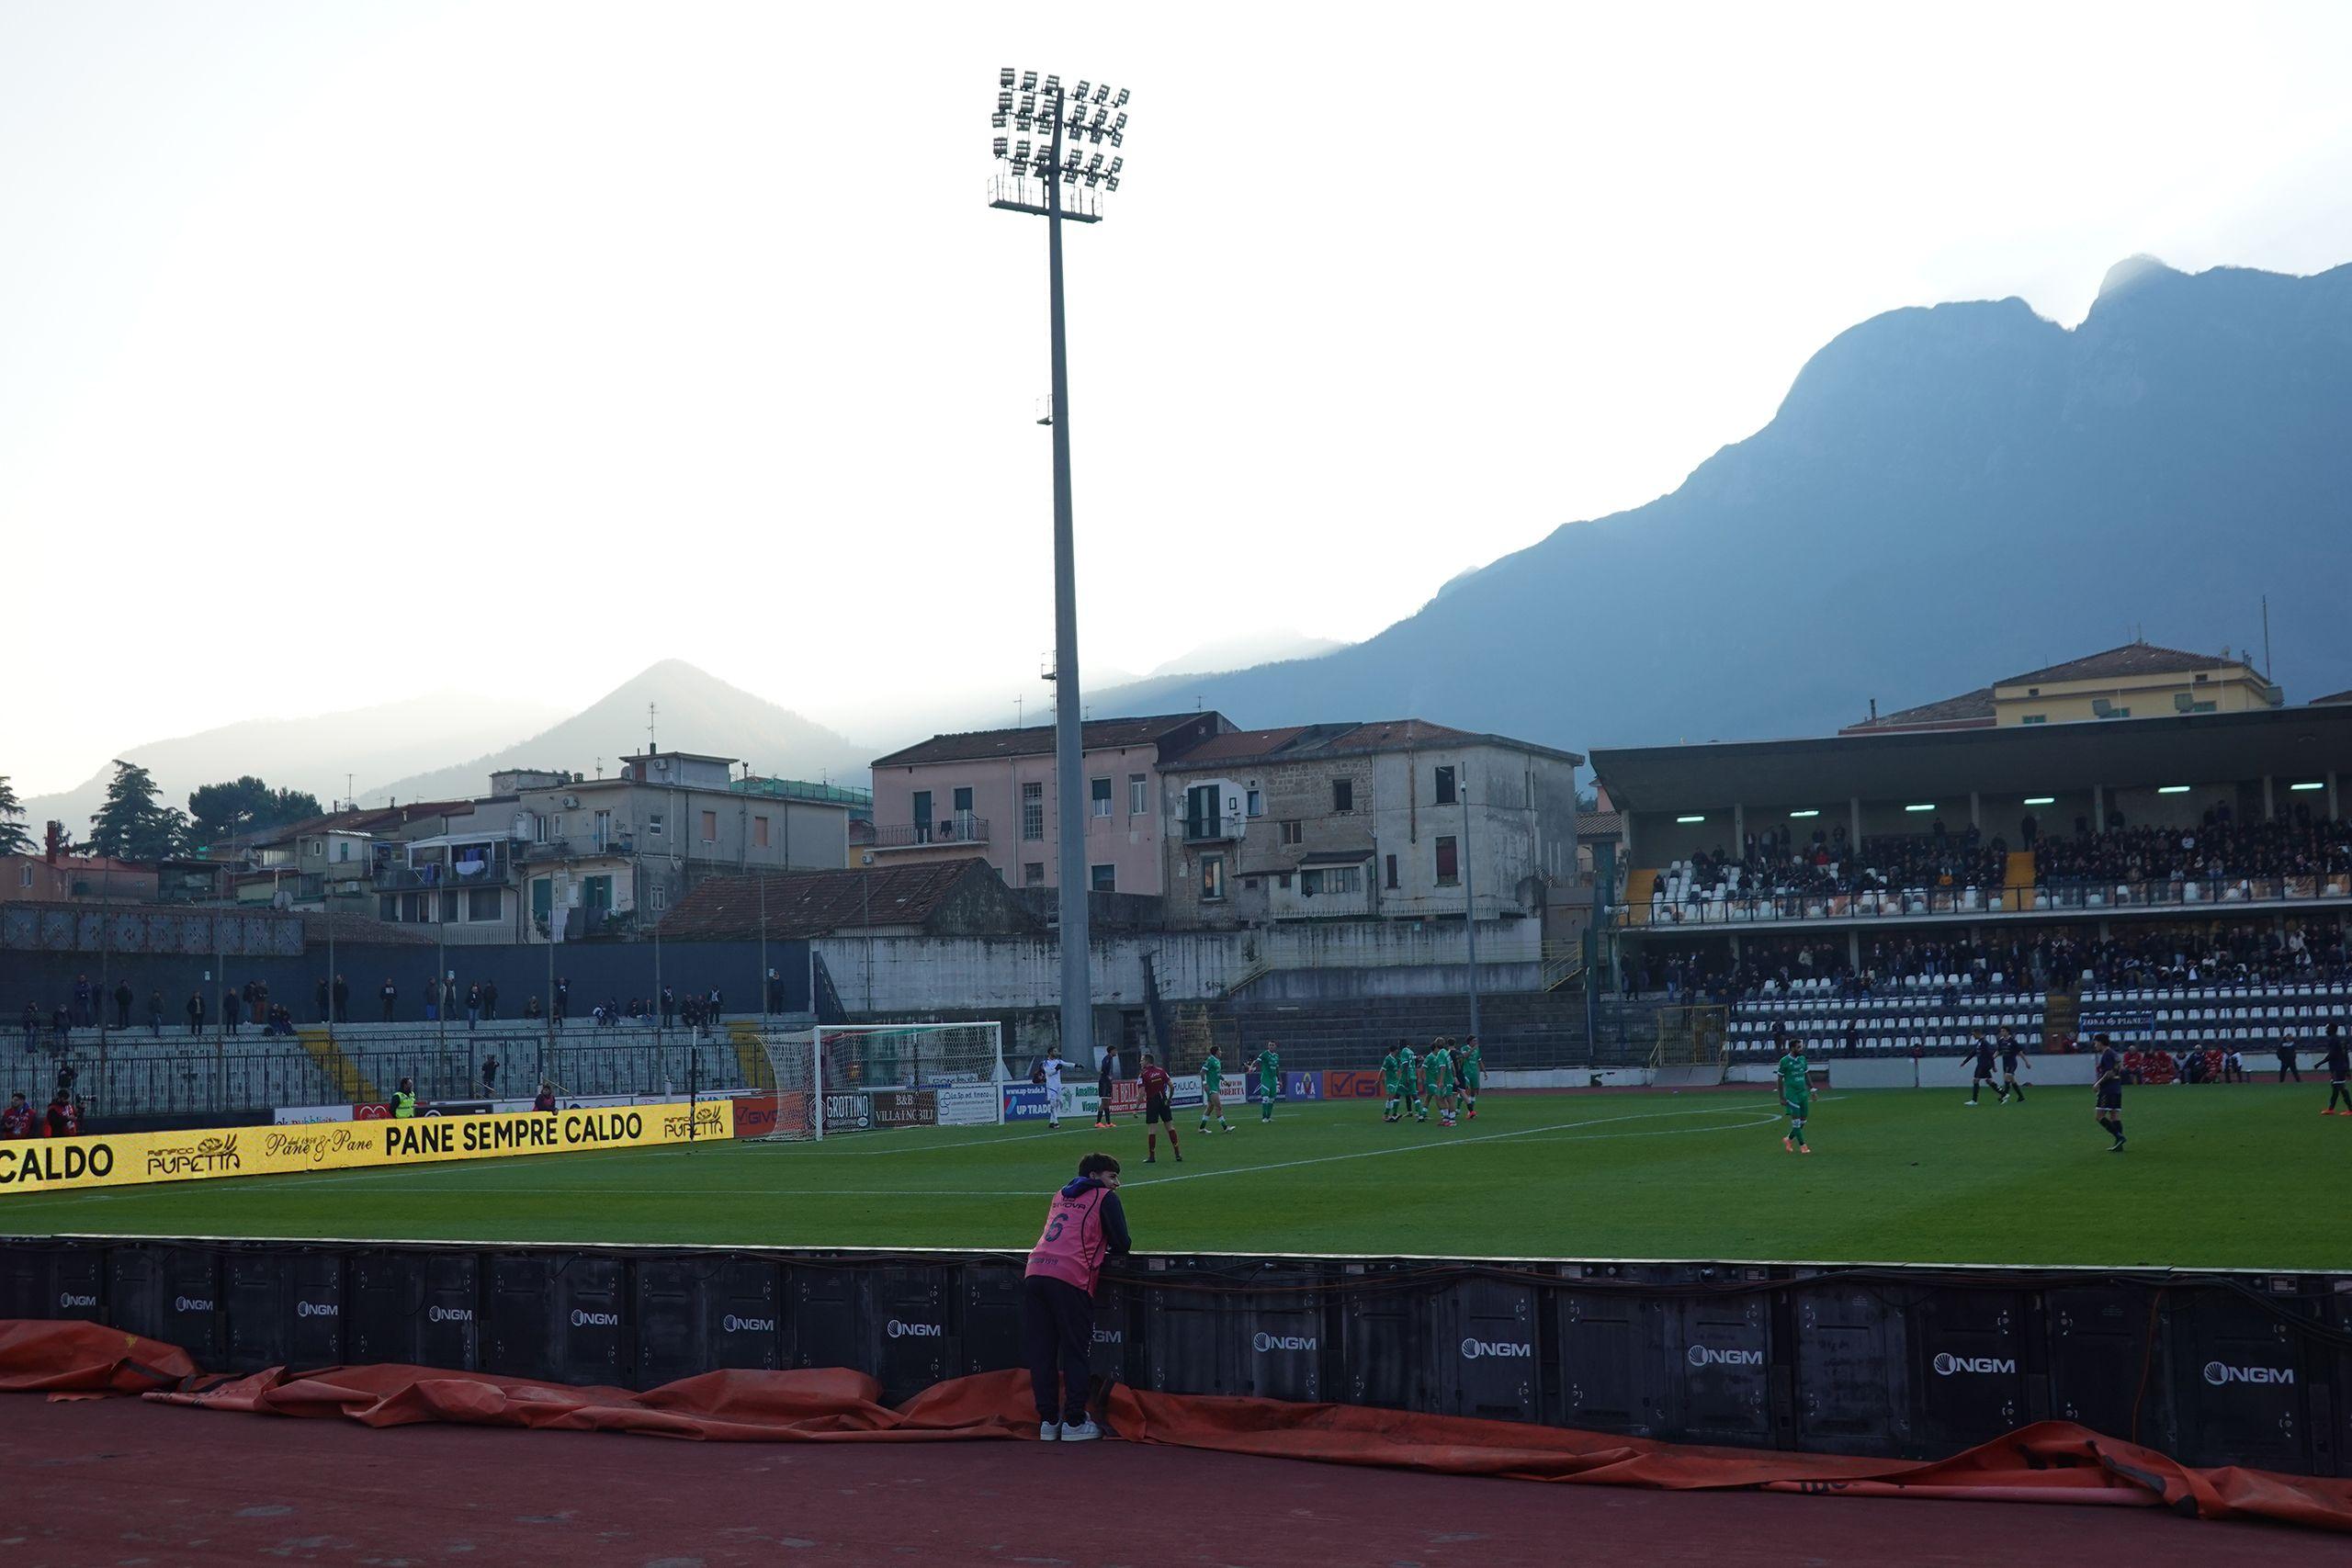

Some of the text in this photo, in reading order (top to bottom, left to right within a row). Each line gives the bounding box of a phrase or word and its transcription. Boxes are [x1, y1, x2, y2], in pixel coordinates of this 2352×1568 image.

[1219, 1087, 1245, 1096] OBERTA
[827, 1095, 869, 1119] GROTTINO
[896, 1094, 913, 1106] B&B
[875, 1110, 900, 1122] VILLA
[1016, 1105, 1027, 1115] UP
[386, 1112, 642, 1156] PANE SEMPRE CALDO
[265, 1133, 311, 1156] Pane
[332, 1129, 373, 1153] Pane
[0, 1144, 113, 1184] CALDO
[147, 1154, 241, 1176] PUPETTA
[1045, 1213, 1069, 1243] 6
[70, 1296, 96, 1306] NGM
[186, 1301, 213, 1311] NGM
[307, 1304, 338, 1316] NGM
[440, 1309, 472, 1322] NGM
[582, 1313, 618, 1325] NGM
[738, 1318, 775, 1331] NGM
[900, 1324, 942, 1337] NGM
[1093, 1329, 1122, 1343] GM
[1271, 1337, 1317, 1351] NGM
[1480, 1342, 1531, 1358] NGM
[1709, 1349, 1763, 1365] NGM
[1956, 1357, 2016, 1374] NGM
[2229, 1367, 2294, 1384] NGM
